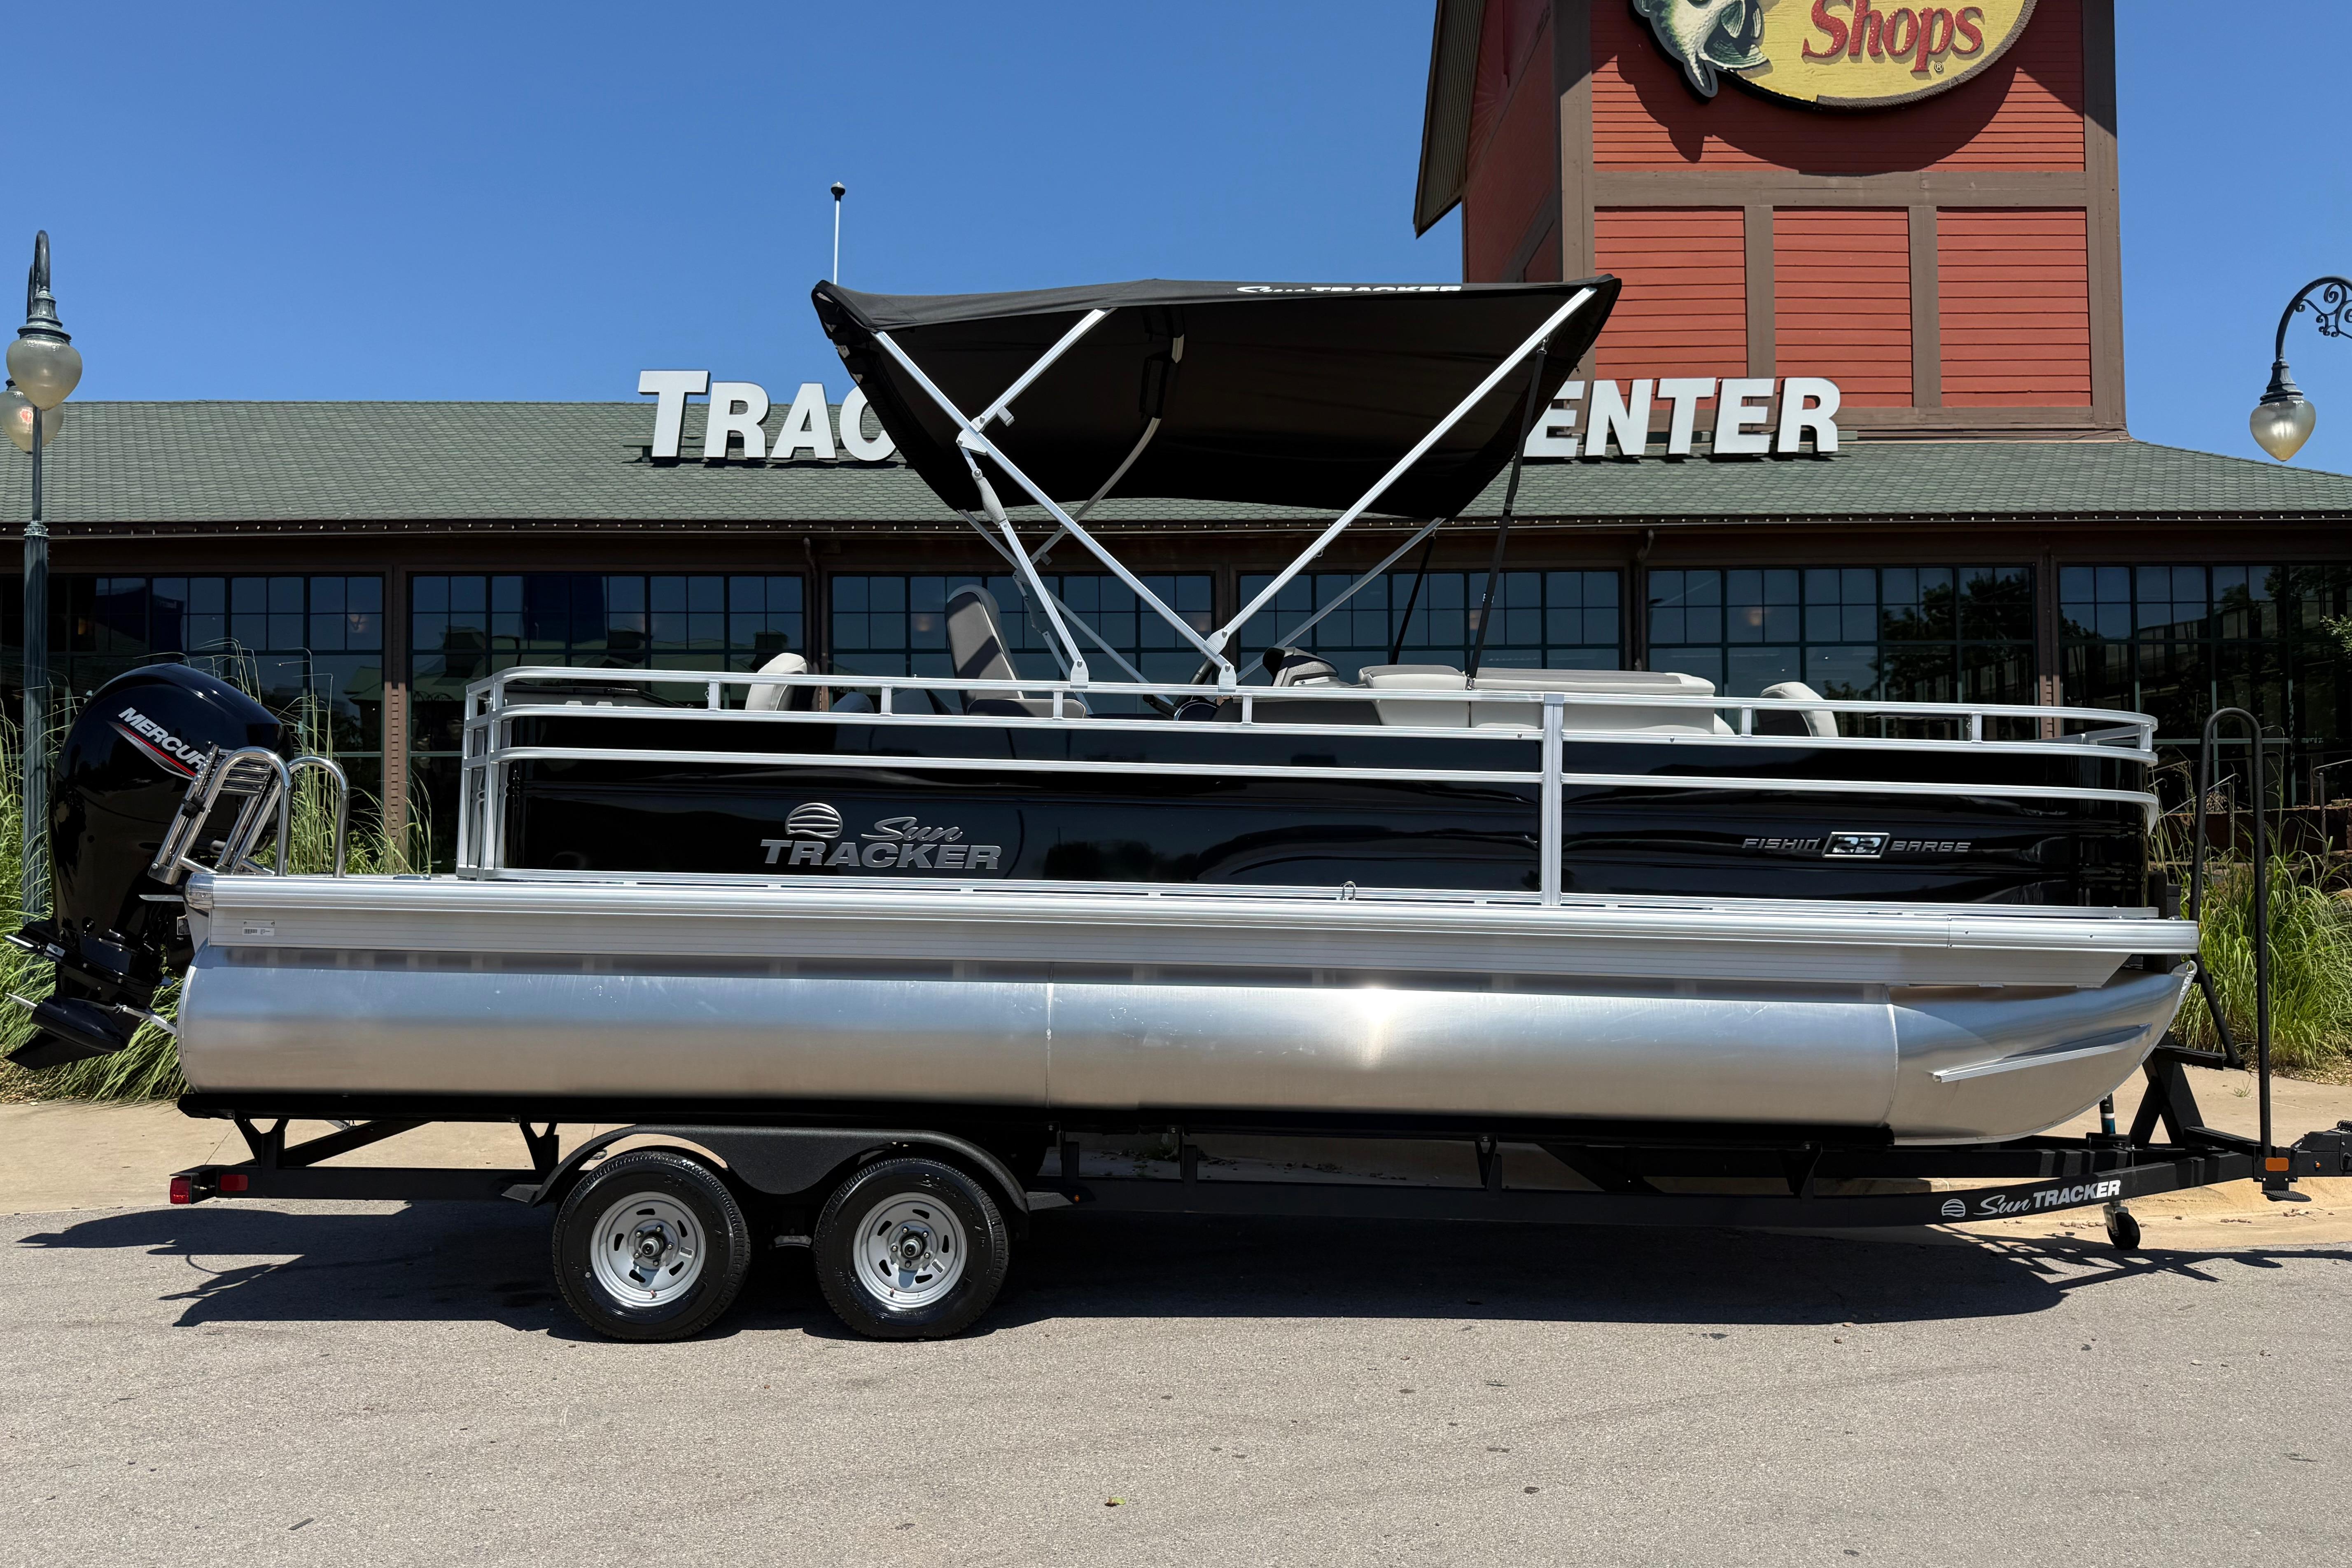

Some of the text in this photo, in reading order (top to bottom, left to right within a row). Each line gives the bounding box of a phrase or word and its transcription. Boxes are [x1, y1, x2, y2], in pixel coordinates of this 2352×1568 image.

[1802, 0, 1983, 73] Shops
[1523, 377, 1841, 457] ENTER
[861, 817, 964, 842] Sun
[1832, 836, 1881, 854] 22
[1890, 840, 1972, 853] BARGE
[760, 839, 1002, 870] TRACKER
[1973, 1180, 2121, 1216] Sun TRACKER
